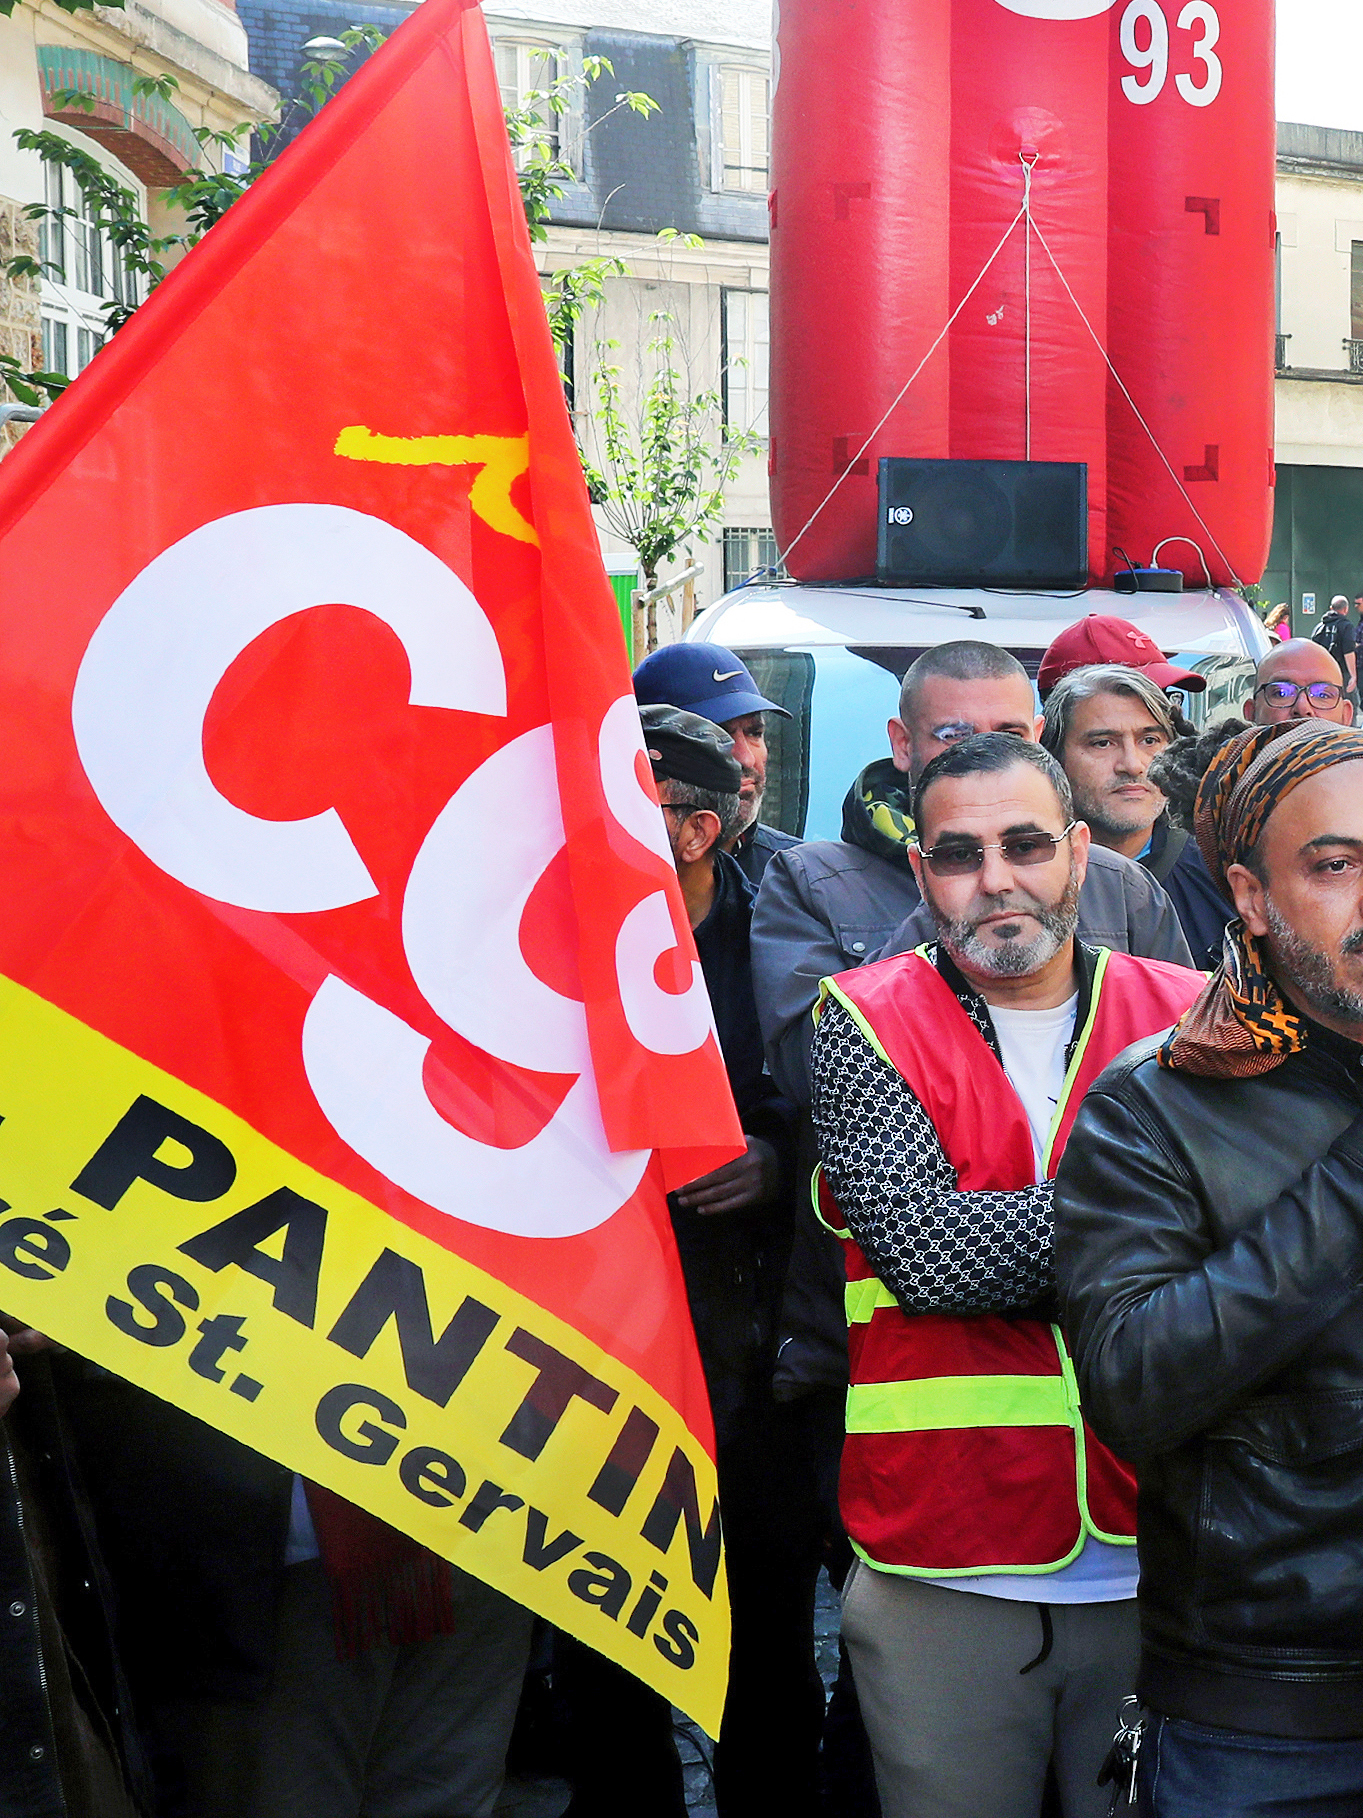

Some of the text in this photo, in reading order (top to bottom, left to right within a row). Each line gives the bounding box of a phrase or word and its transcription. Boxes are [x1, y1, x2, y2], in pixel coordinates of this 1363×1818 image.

[1119, 0, 1223, 107] 93
[70, 1092, 723, 1602] PANTIN
[105, 1263, 263, 1403] St.
[314, 1382, 700, 1671] Gervais
